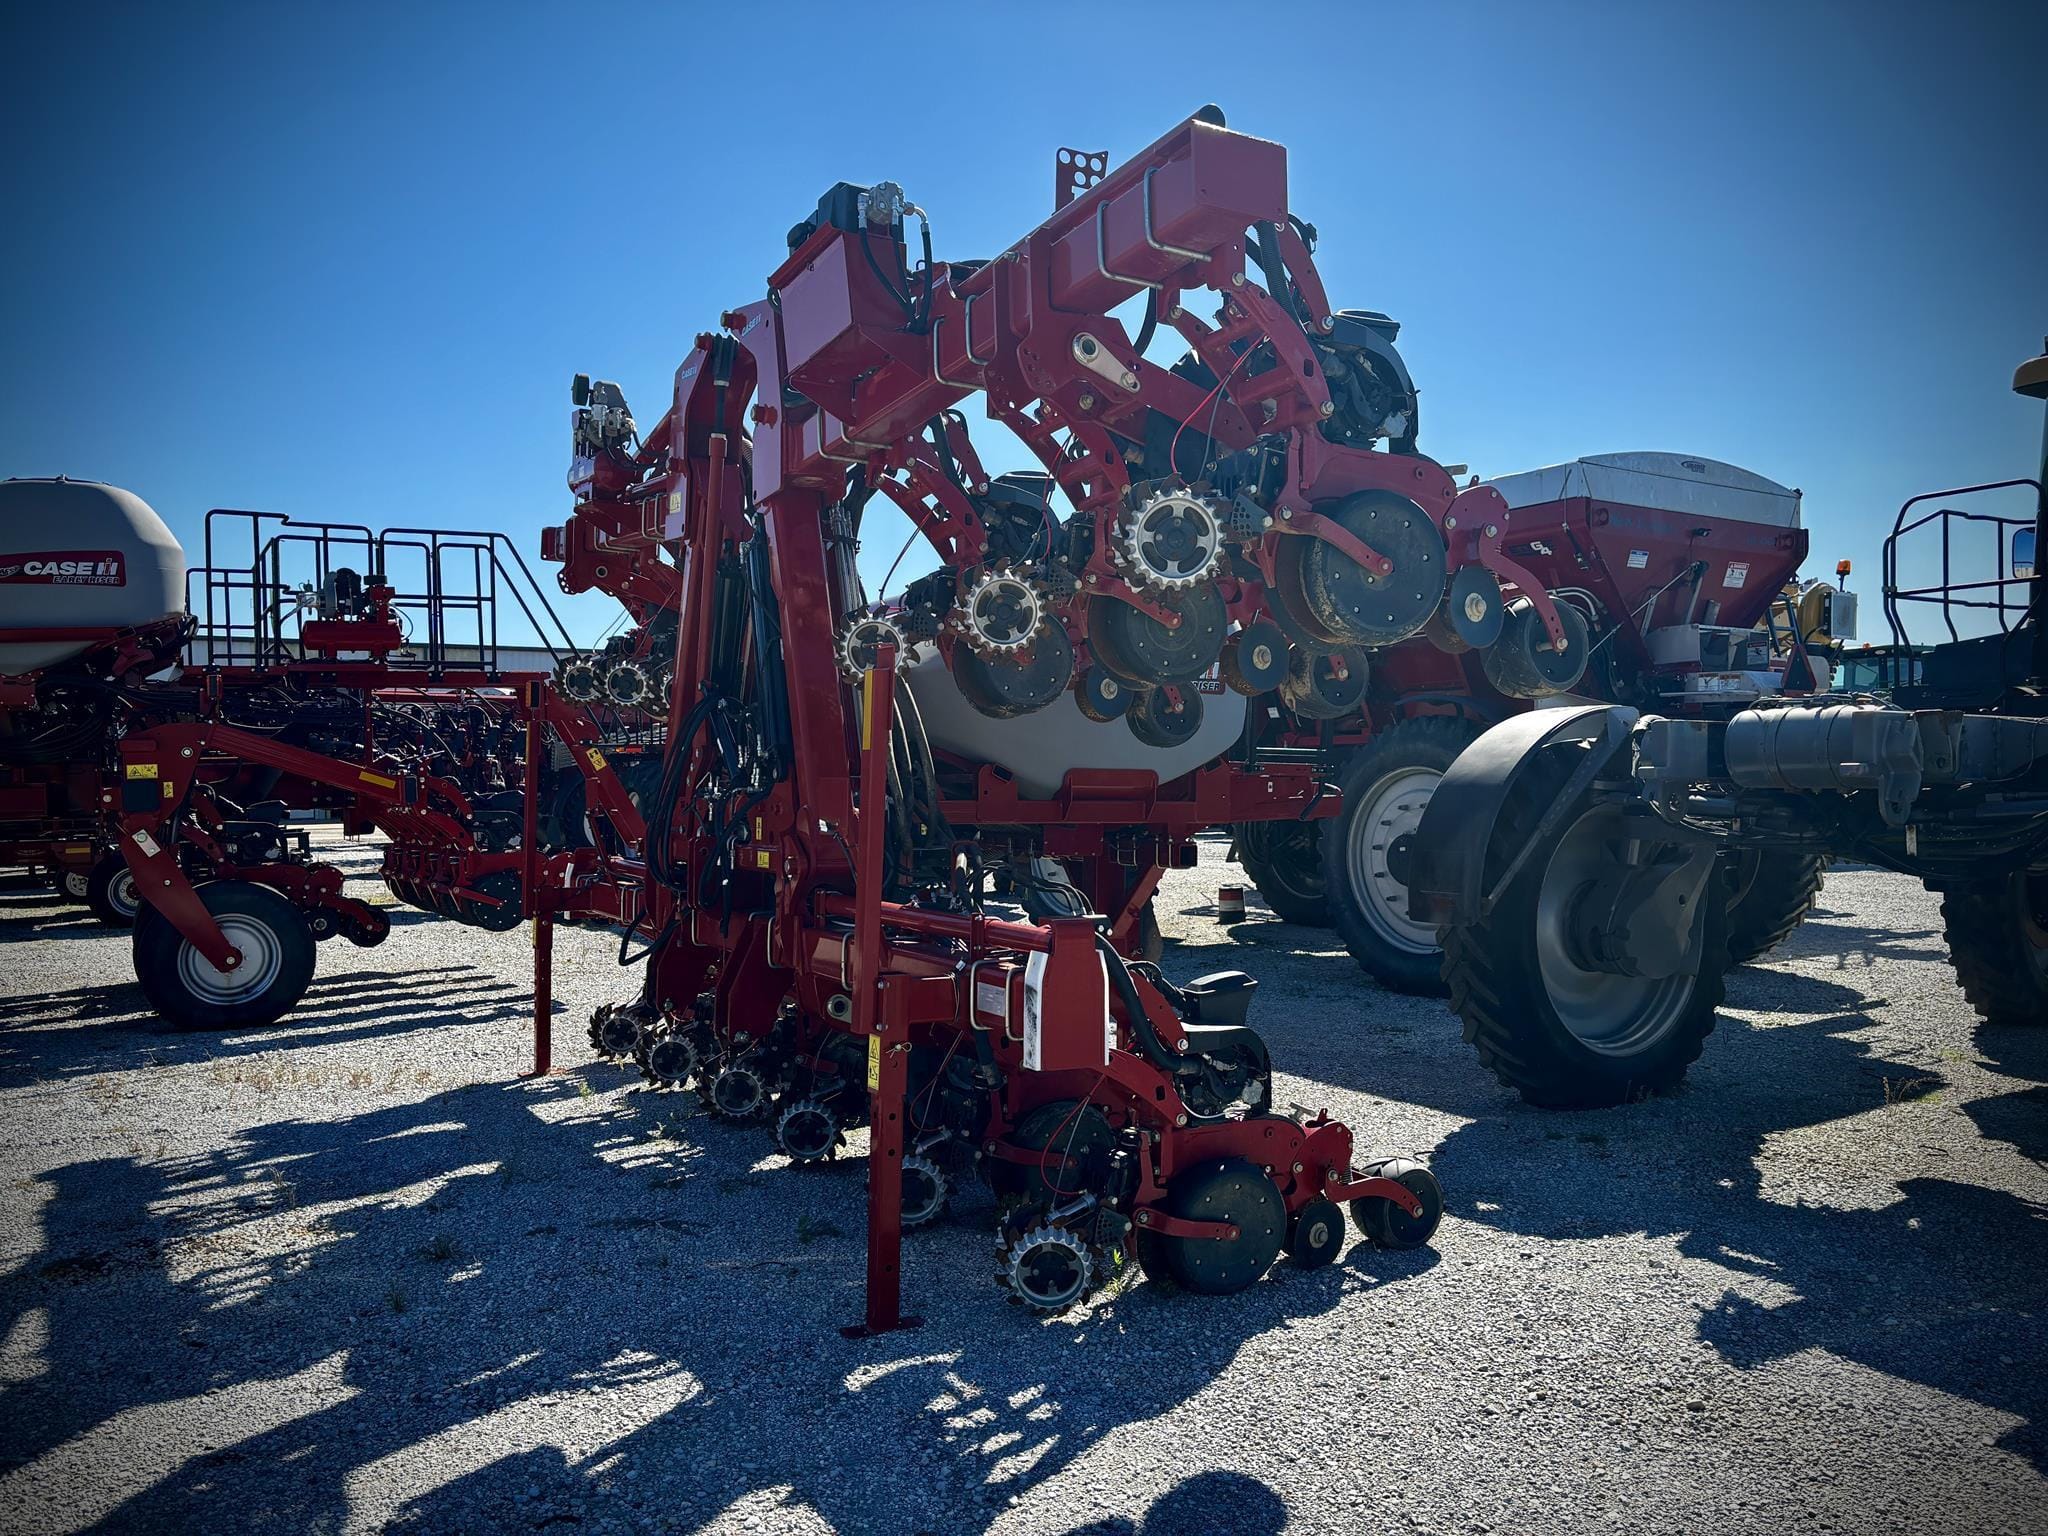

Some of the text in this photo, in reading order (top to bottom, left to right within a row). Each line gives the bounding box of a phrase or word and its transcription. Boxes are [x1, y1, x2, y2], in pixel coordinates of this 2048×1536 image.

[1530, 541, 1552, 556] G4
[24, 561, 94, 576] CASE
[53, 576, 119, 585] EARLY RISER
